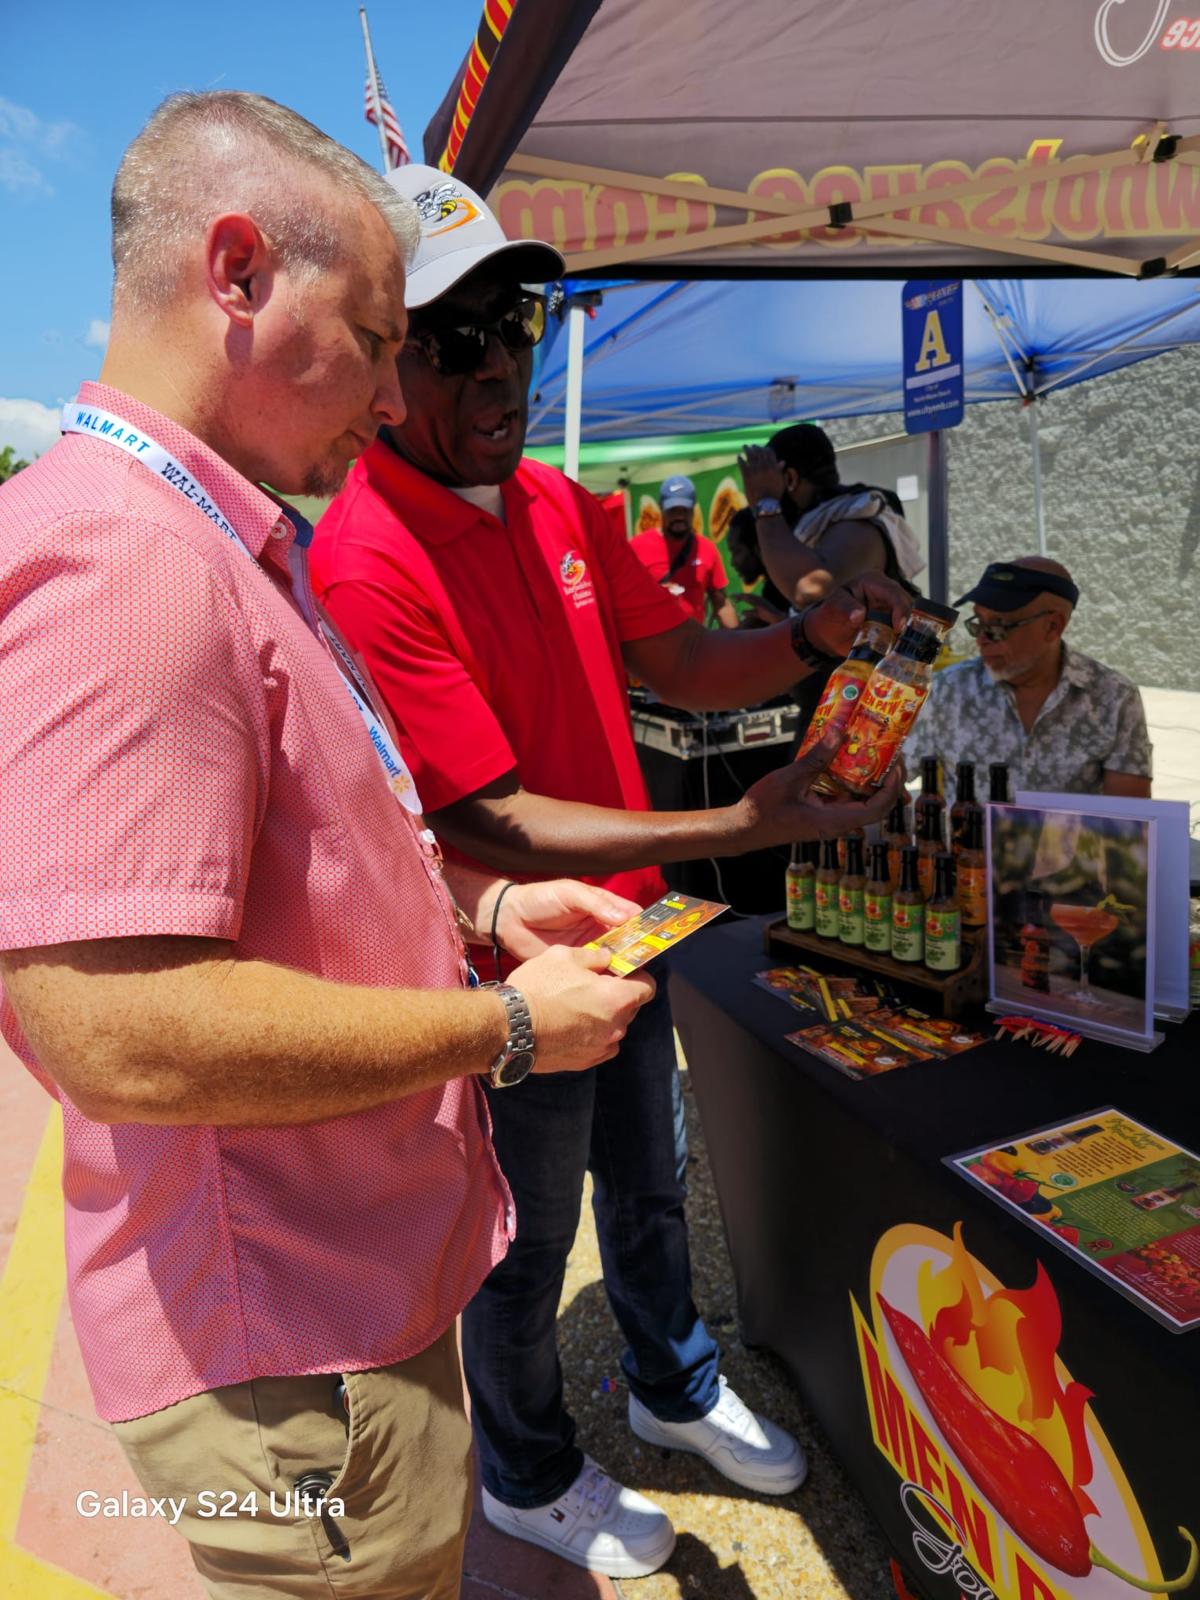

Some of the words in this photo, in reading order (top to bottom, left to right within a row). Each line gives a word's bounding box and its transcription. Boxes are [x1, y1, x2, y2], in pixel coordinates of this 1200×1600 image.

[915, 310, 951, 372] A
[75, 411, 150, 453] WALMART
[160, 461, 238, 540] WAL-MART
[369, 725, 401, 778] Walmart
